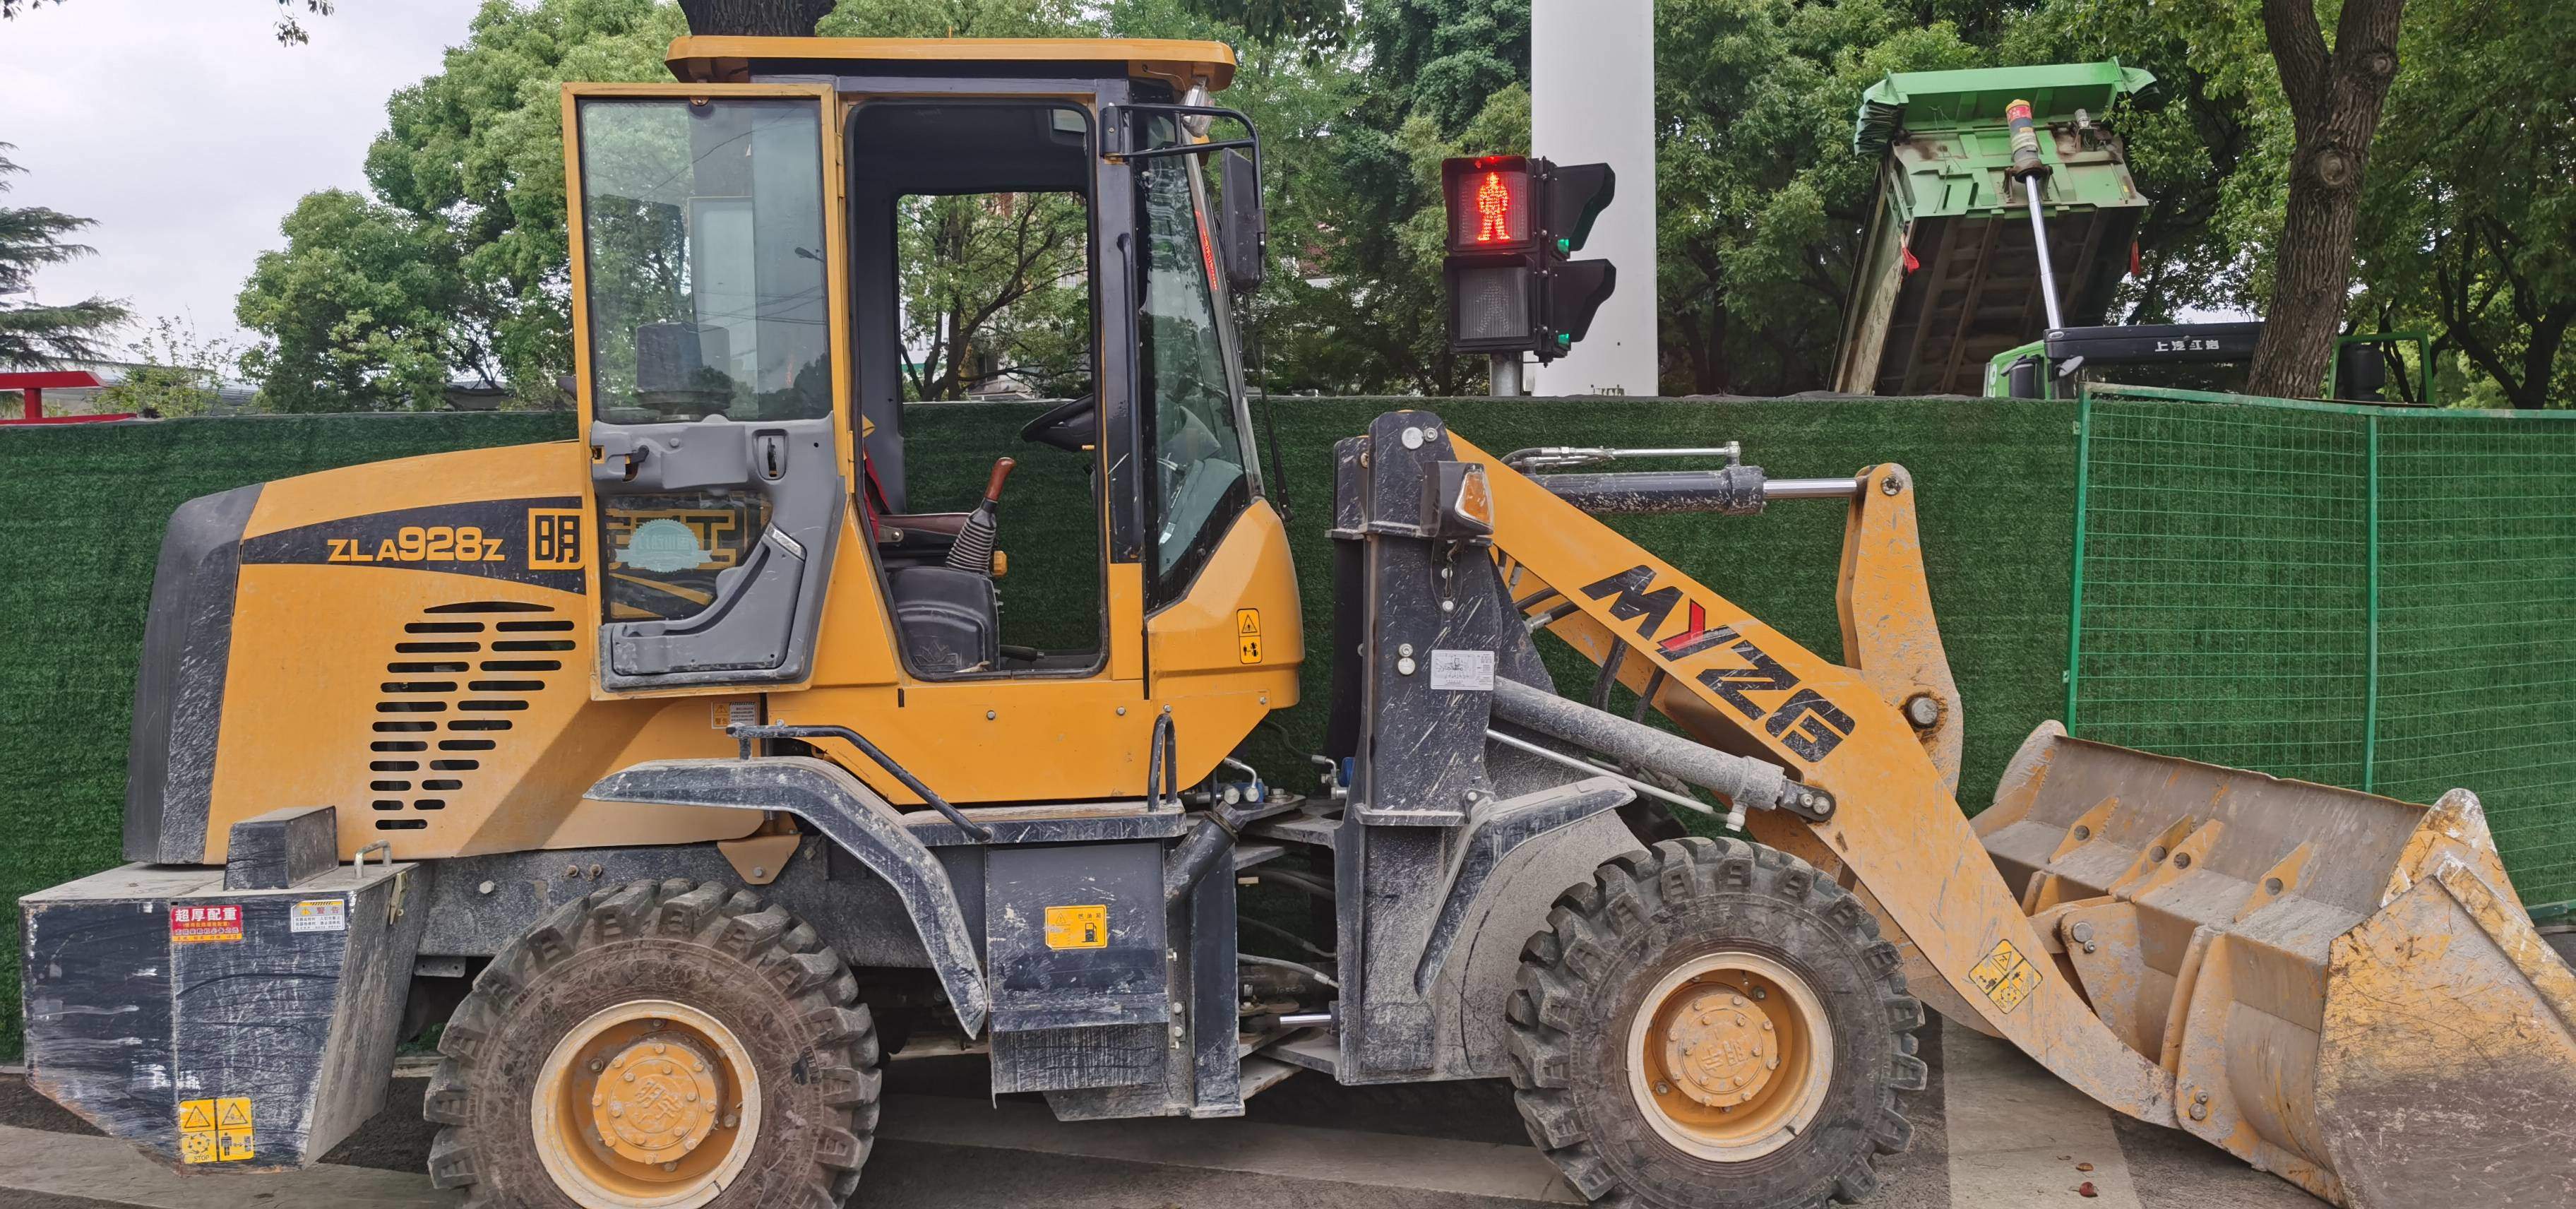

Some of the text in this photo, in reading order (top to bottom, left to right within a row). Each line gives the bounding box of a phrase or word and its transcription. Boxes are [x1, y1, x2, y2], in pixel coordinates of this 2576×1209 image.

[2155, 340, 2219, 352] 上汽红岩
[328, 526, 505, 562] ZLA928Z
[1579, 565, 1855, 763] MYZG
[174, 907, 237, 922] 超厚配重
